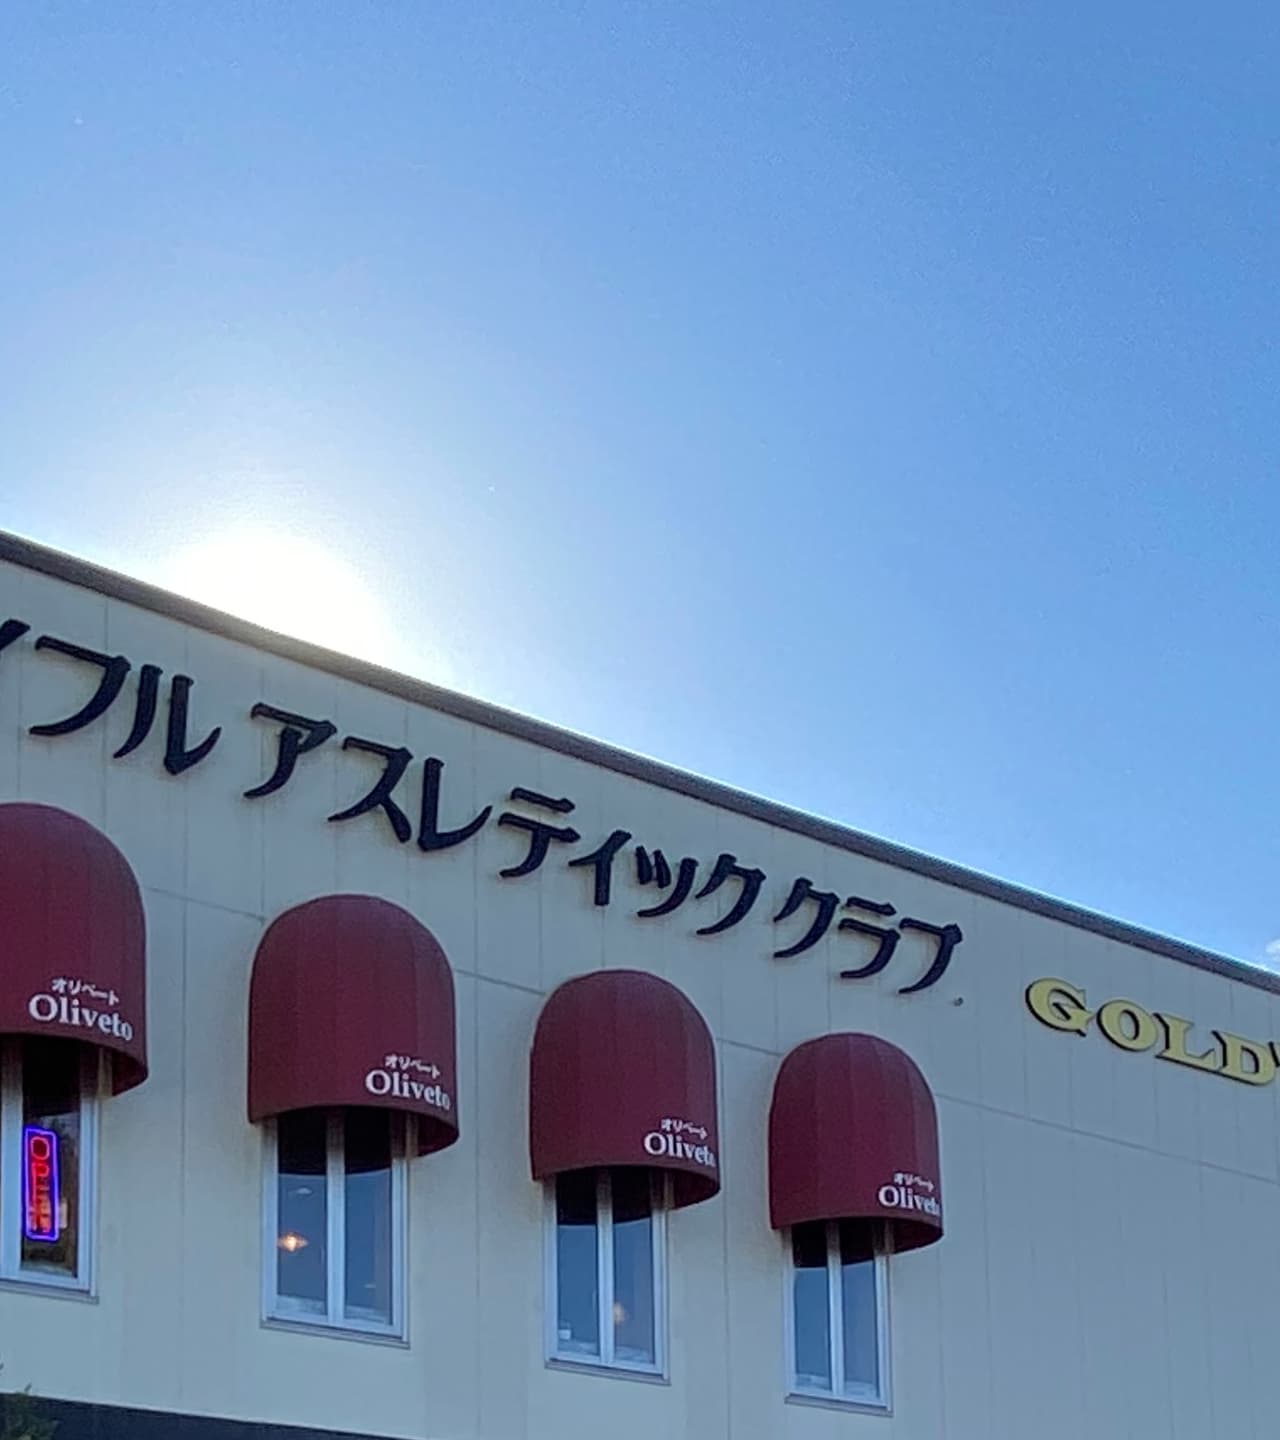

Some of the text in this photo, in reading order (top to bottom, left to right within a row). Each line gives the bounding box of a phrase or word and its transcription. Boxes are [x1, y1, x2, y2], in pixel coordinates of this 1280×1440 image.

[243, 702, 767, 936] アスレティック
[51, 977, 119, 1005] オリベート
[28, 993, 133, 1041] Oliveto
[365, 1069, 451, 1111] Oliveto
